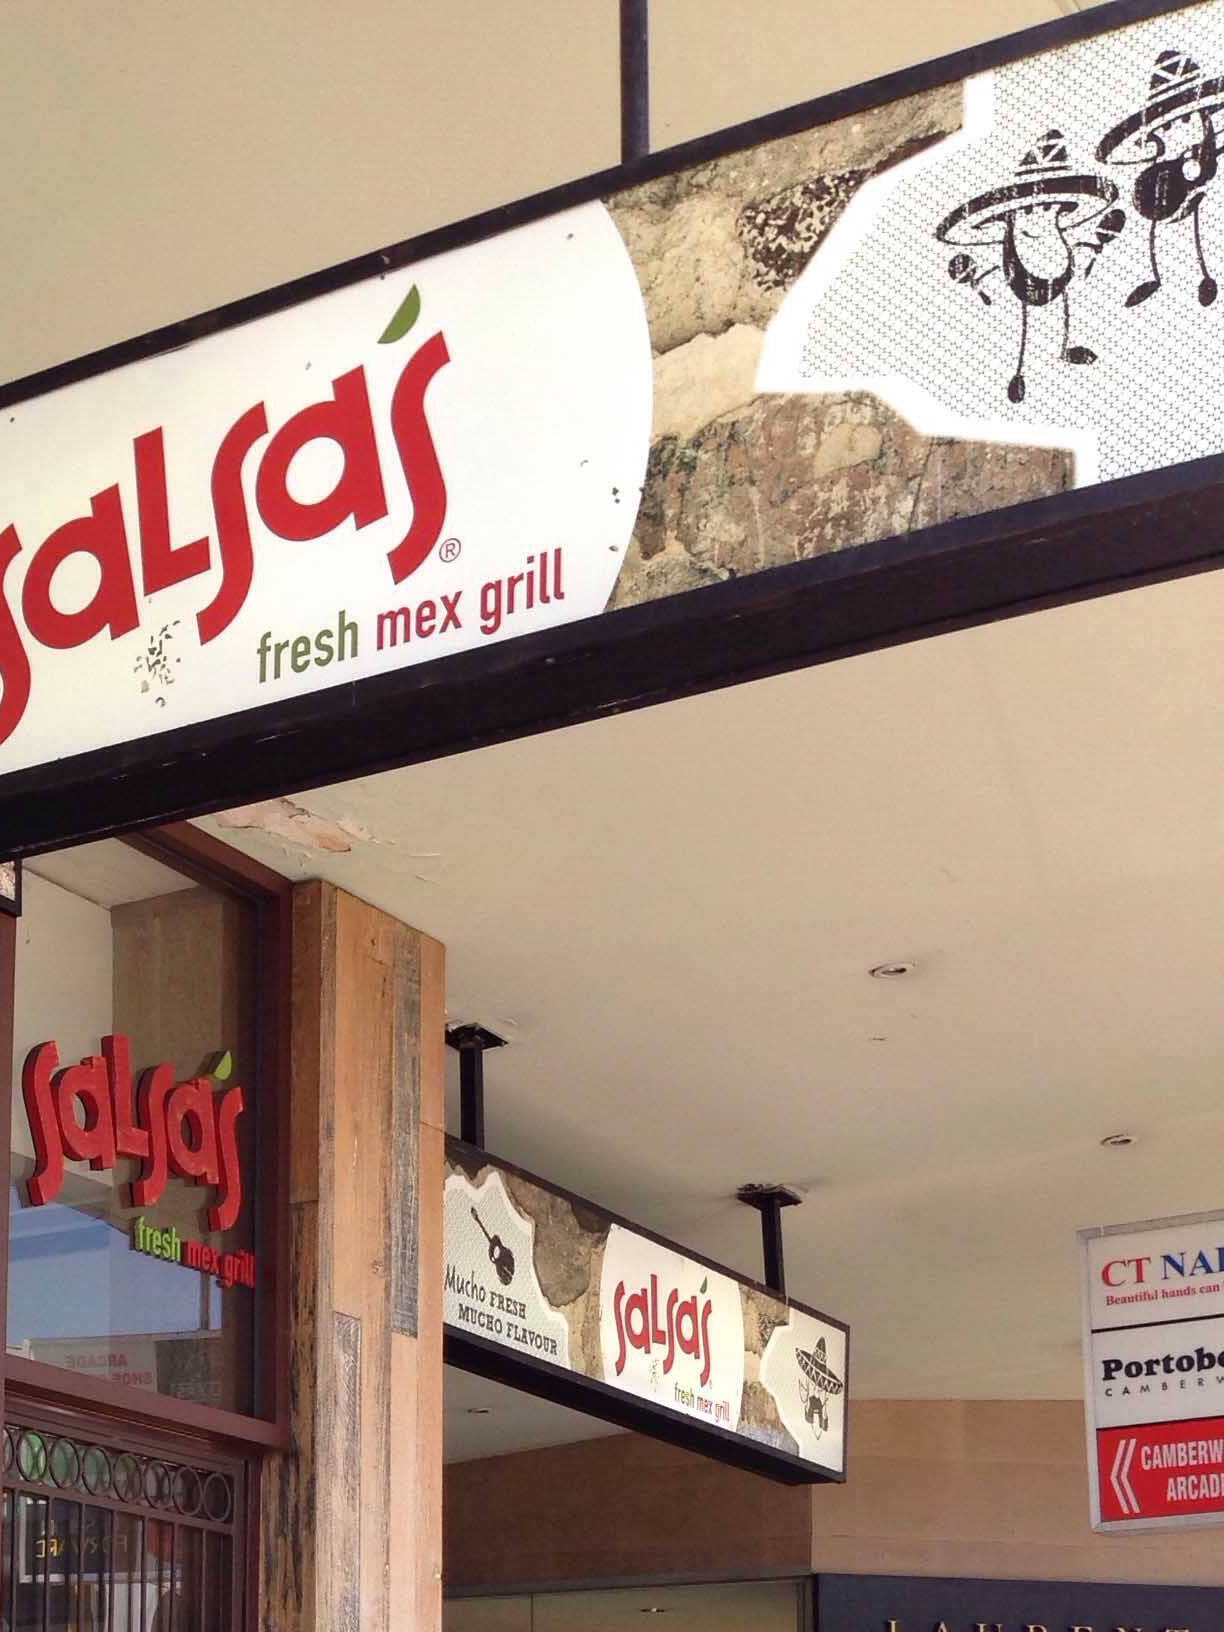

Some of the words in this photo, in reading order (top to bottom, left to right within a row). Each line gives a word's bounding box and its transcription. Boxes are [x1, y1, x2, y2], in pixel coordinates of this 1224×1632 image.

[257, 609, 360, 684] fresh
[376, 590, 463, 651] mex
[479, 547, 565, 636] grill
[134, 1215, 182, 1263] fresh
[183, 1240, 220, 1276] mex
[222, 1248, 256, 1289] grill
[1101, 1256, 1152, 1288] CT
[444, 1263, 487, 1303] Mucho
[488, 1290, 527, 1321] FRESH
[1105, 1288, 1159, 1307] Beautiful
[1161, 1285, 1197, 1300] hands
[1199, 1282, 1221, 1295] can
[457, 1302, 503, 1334] MUCHO
[506, 1321, 558, 1356] FLAVOUR
[674, 1381, 695, 1408] fresh
